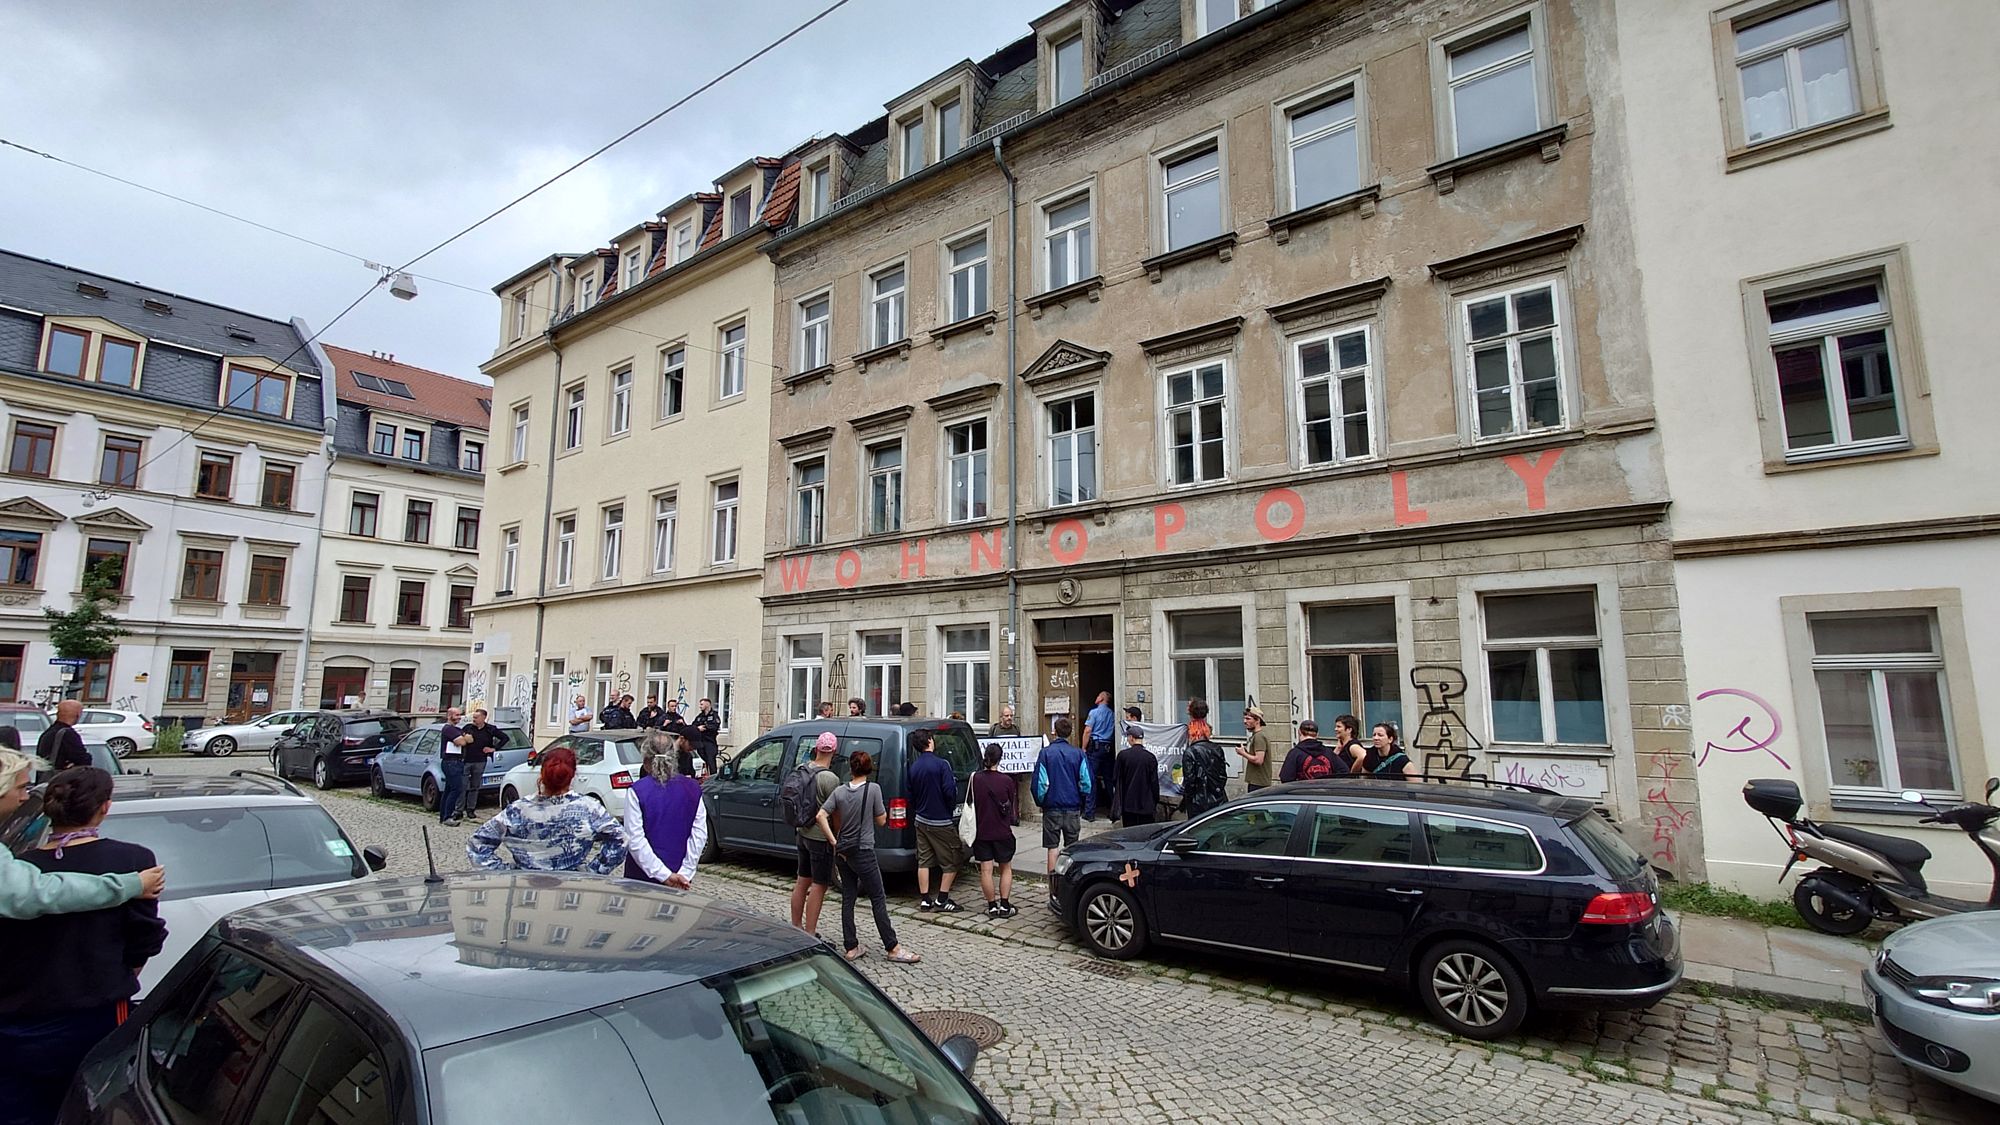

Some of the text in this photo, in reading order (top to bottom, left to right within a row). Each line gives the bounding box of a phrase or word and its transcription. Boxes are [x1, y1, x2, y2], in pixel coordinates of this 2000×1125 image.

[780, 450, 1563, 592] WOHNOPOLY
[980, 741, 1031, 750] AZIALE
[1001, 751, 1027, 761] RKT-
